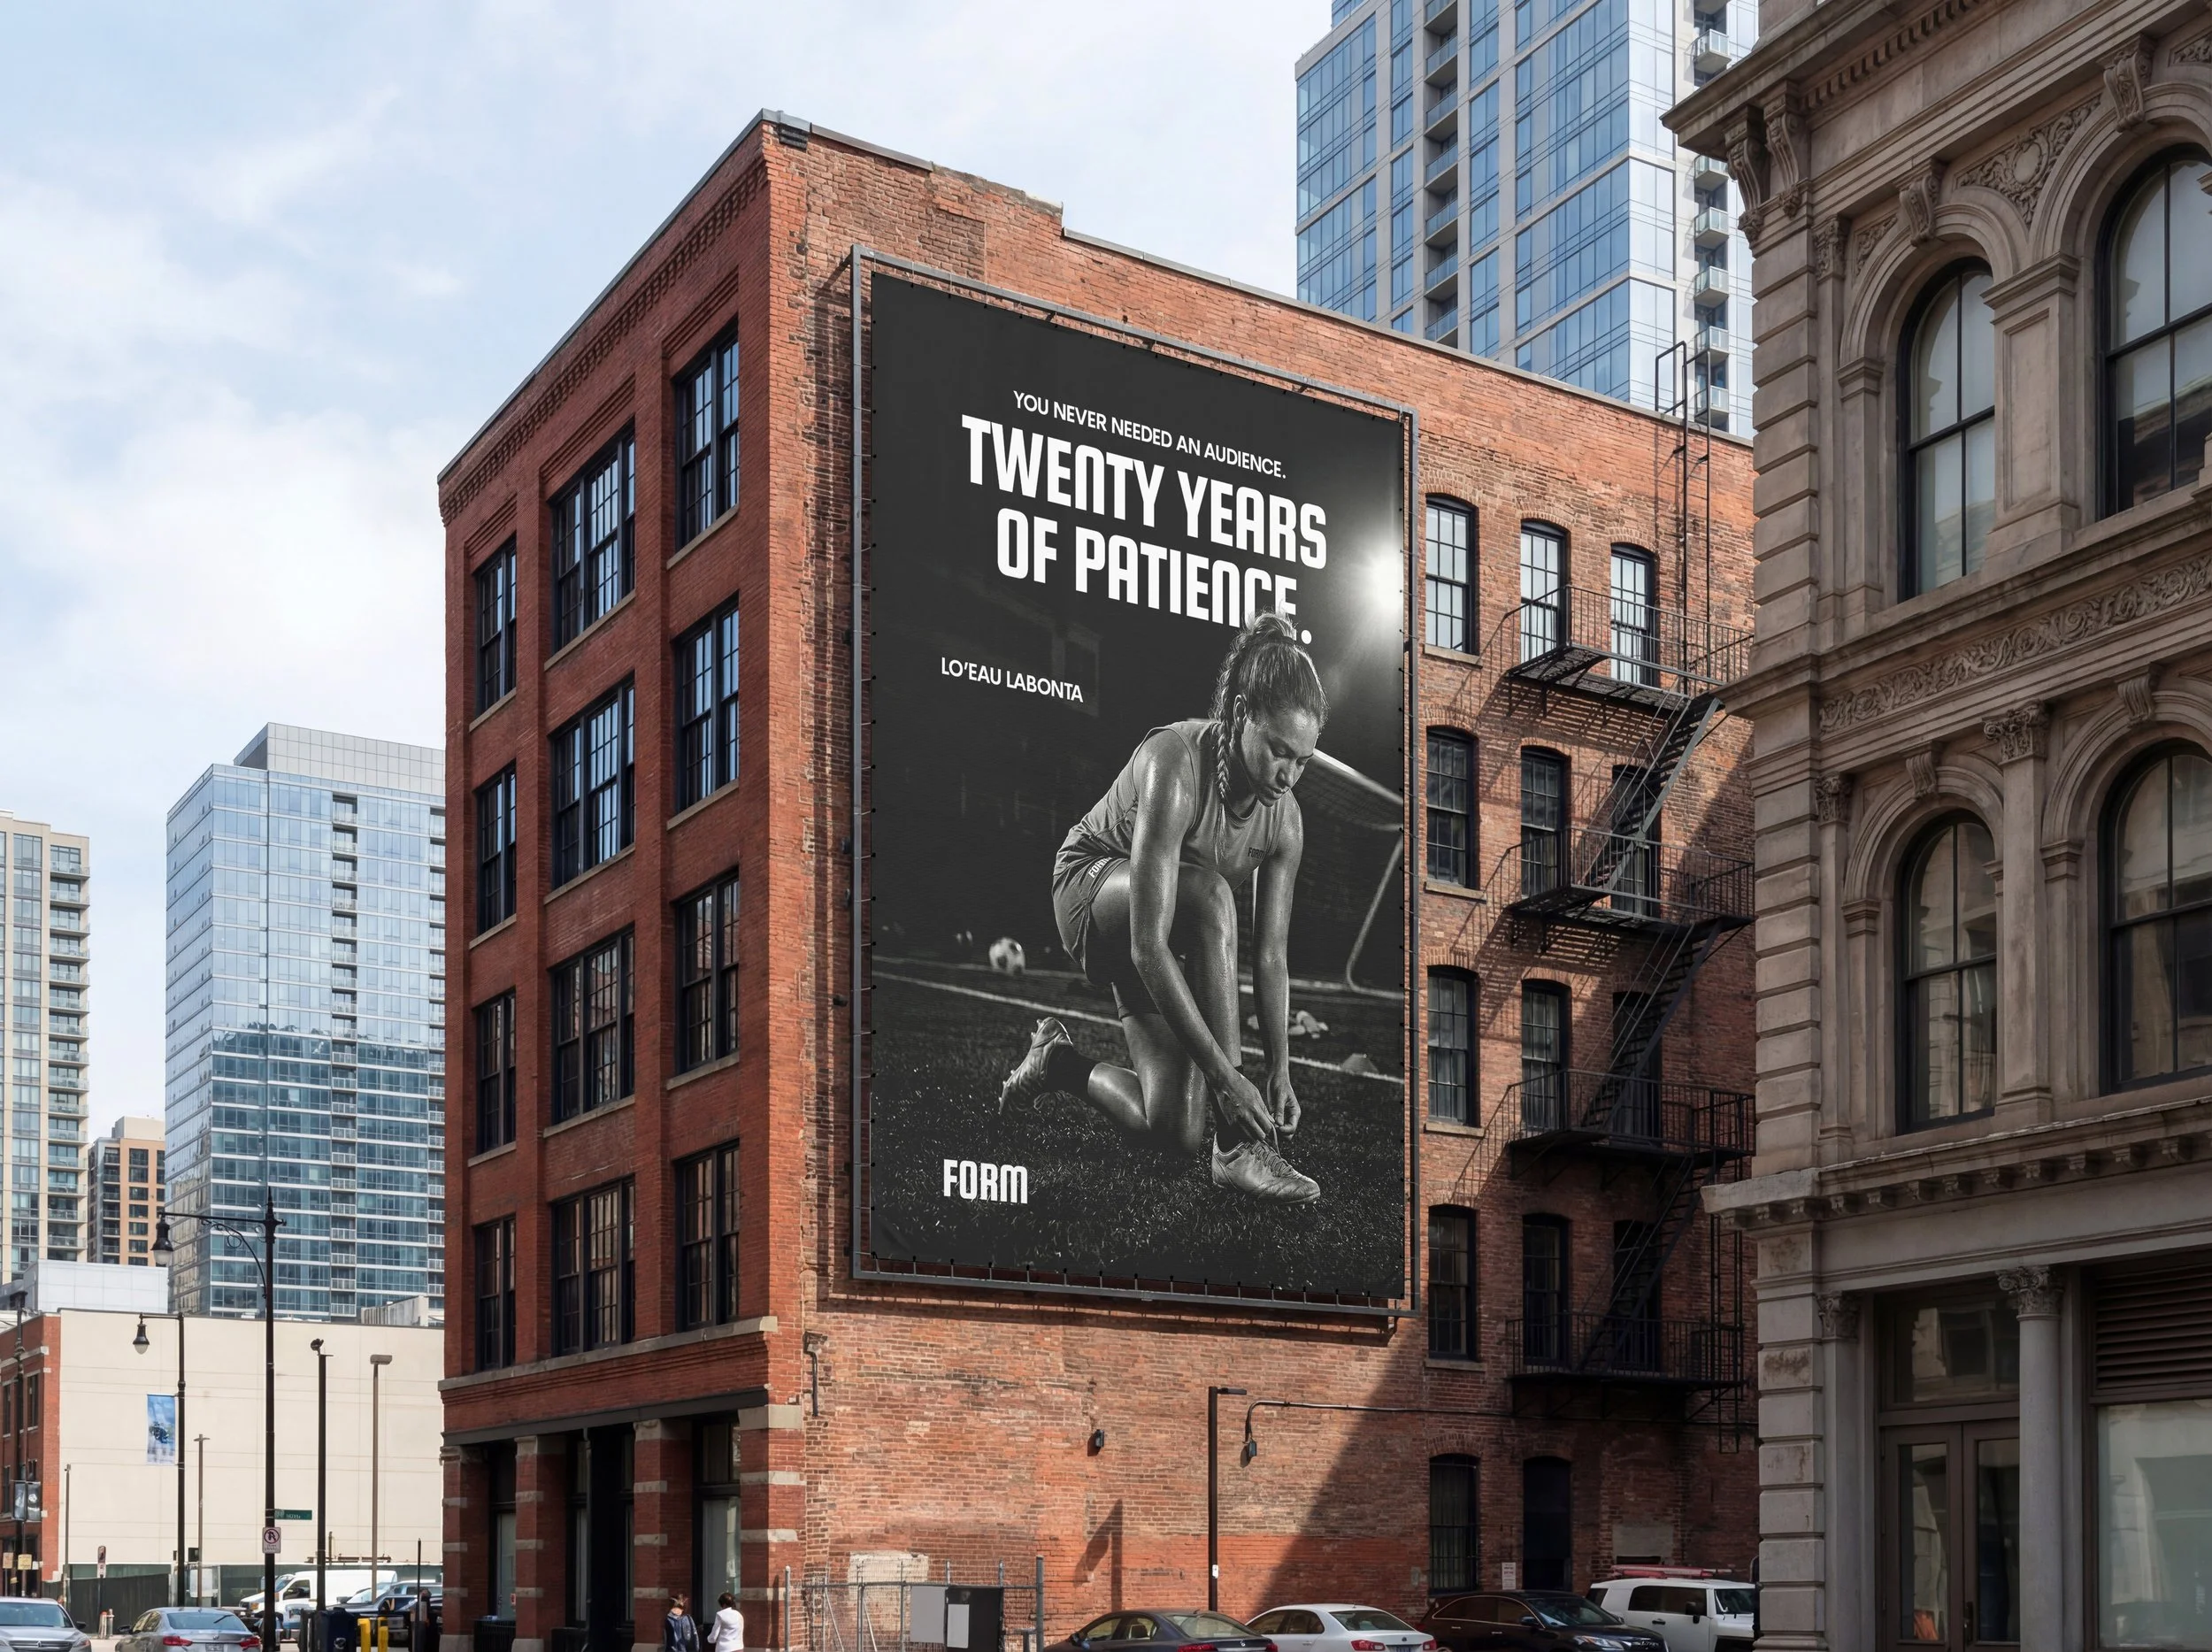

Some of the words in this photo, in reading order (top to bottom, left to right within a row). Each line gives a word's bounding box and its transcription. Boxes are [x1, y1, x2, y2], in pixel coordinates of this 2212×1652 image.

[1013, 390, 1048, 416] YOU
[1053, 401, 1107, 432] NEVER
[1111, 416, 1172, 448] NEEDED
[1175, 434, 1201, 457] AN
[1203, 442, 1286, 479] AUDIENCE.
[961, 414, 1164, 527] TWENTY
[1177, 470, 1327, 569] YEARS
[997, 507, 1058, 584] OF
[1075, 526, 1312, 645] PATIENCE.
[941, 657, 1002, 686] LO'EAU
[1006, 670, 1084, 703] LABONTA
[1248, 847, 1265, 860] FORM
[943, 1158, 1028, 1204] FORM
